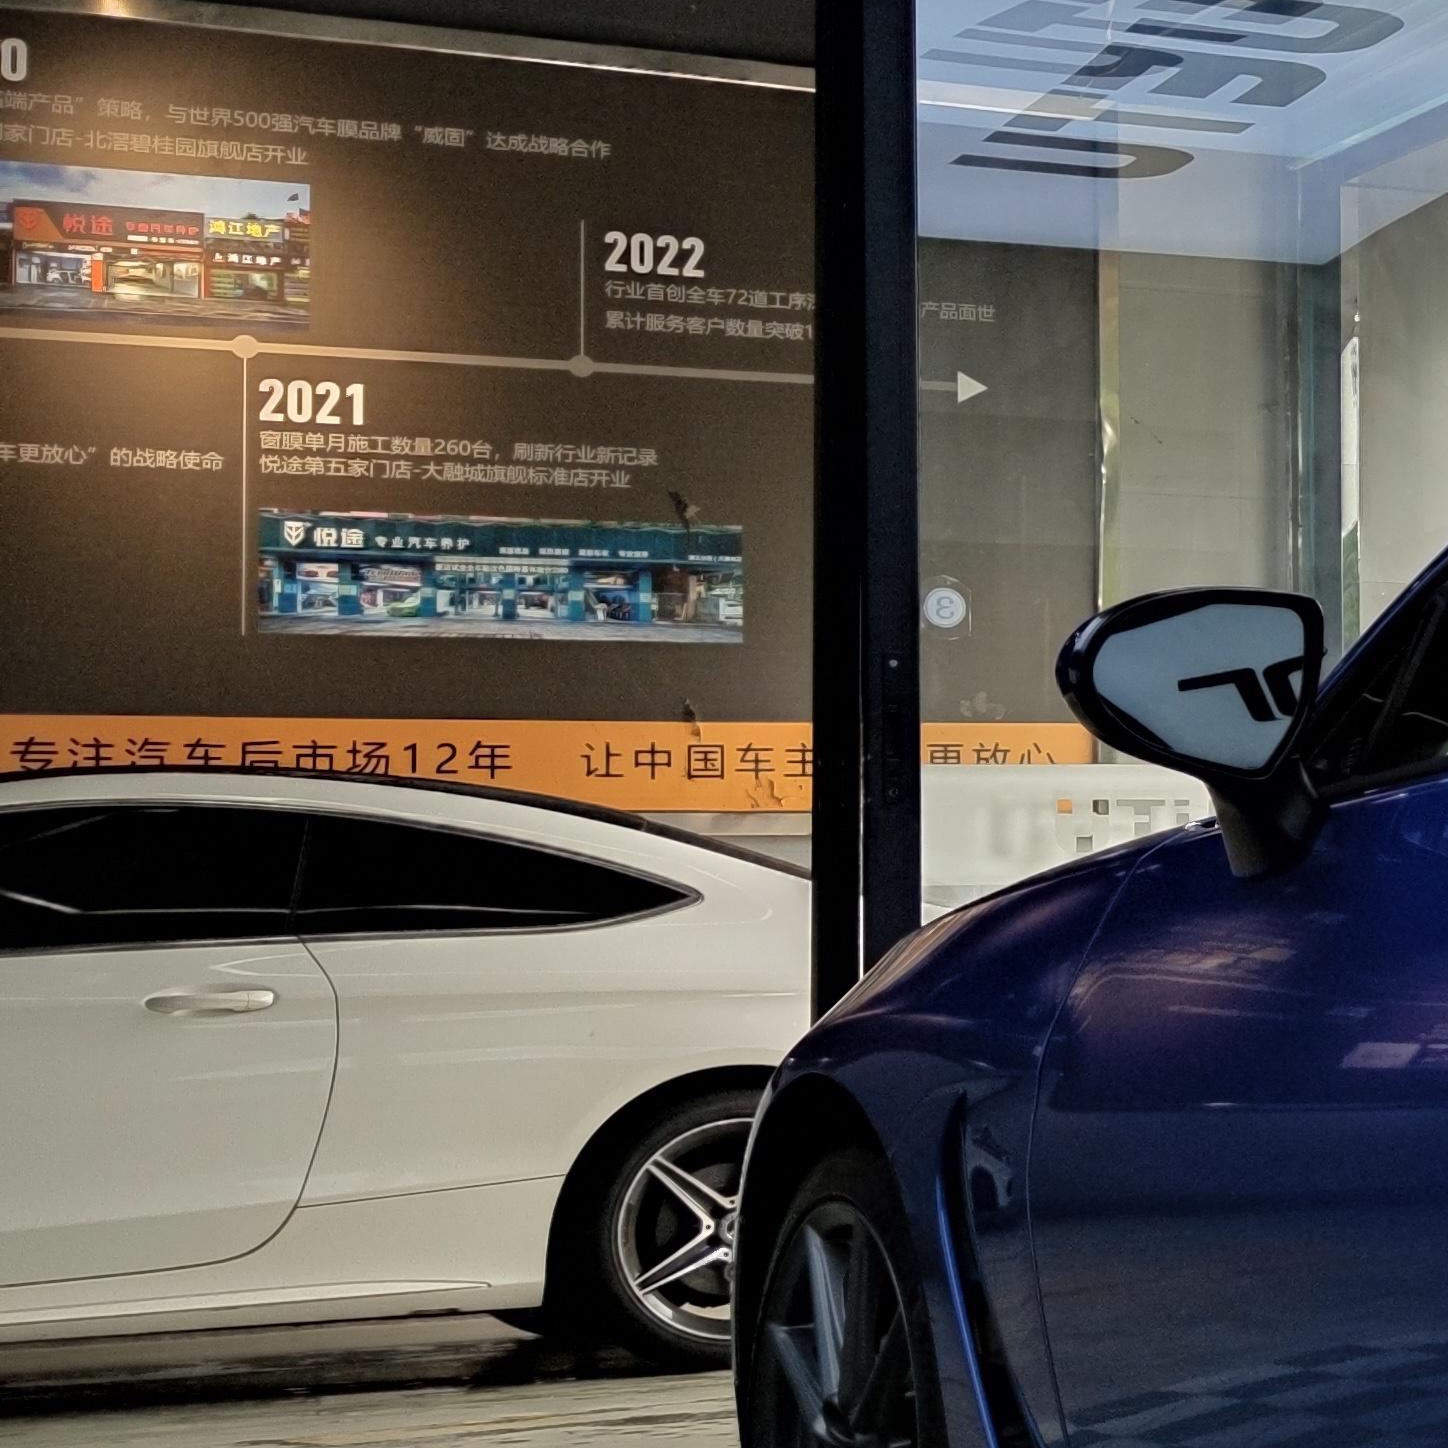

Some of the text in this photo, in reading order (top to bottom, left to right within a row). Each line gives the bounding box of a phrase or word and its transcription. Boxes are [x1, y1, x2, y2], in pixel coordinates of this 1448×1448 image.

[604, 230, 705, 278] 2022
[258, 377, 365, 426] 2021
[10, 736, 513, 780] 专注汽车后市场12年
